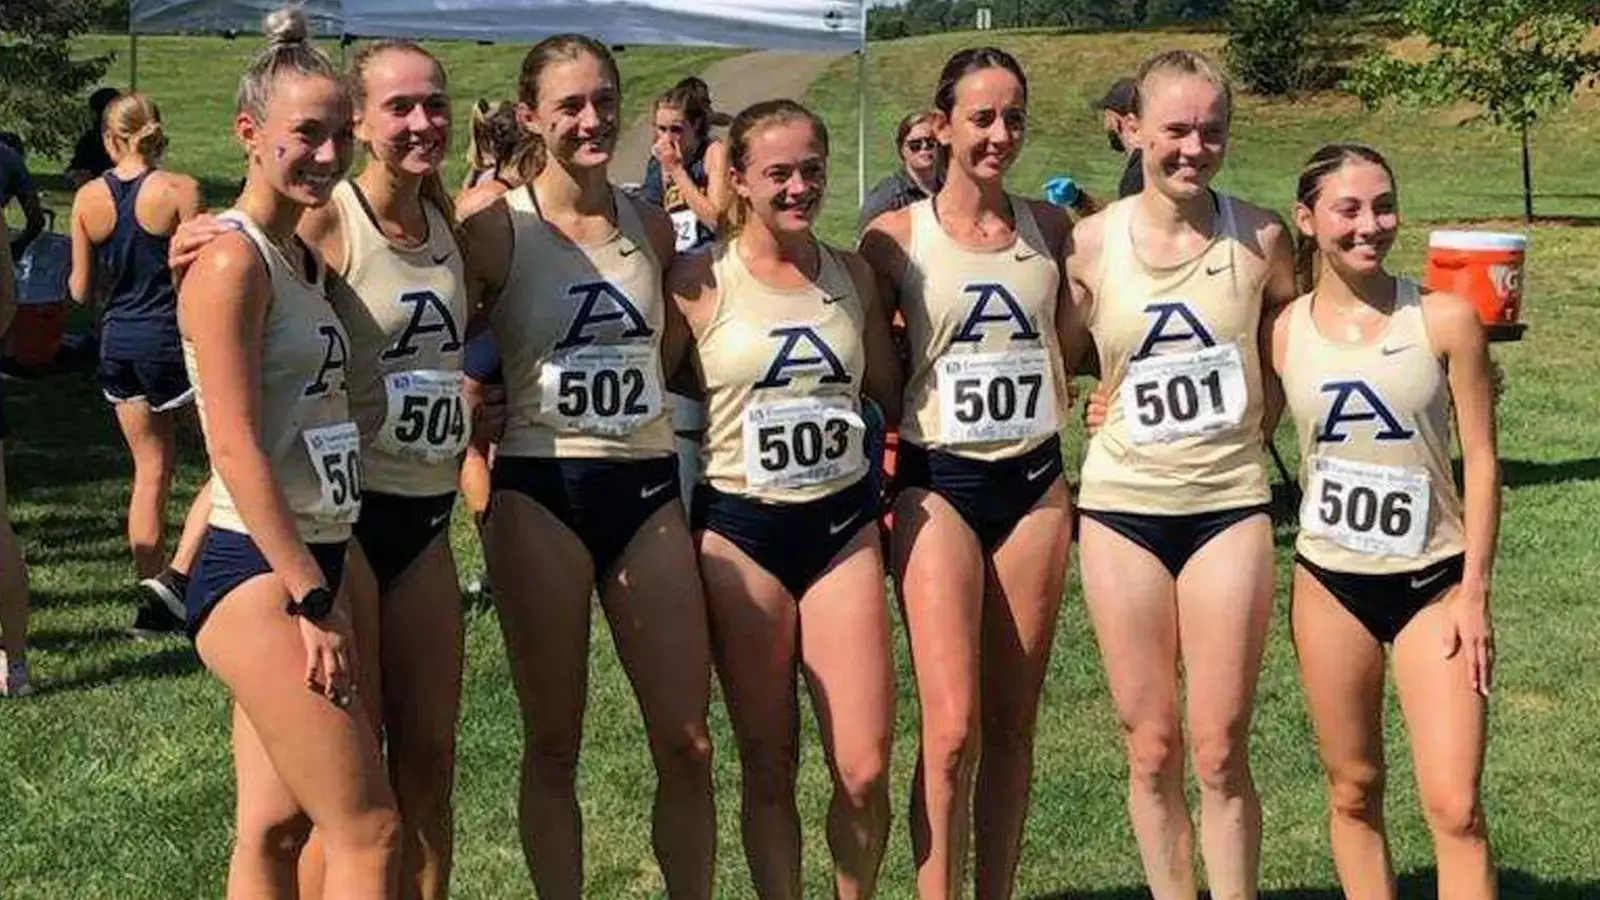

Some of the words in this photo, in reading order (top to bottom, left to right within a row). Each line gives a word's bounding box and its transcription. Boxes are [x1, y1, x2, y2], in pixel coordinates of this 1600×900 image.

[382, 290, 461, 360] A
[554, 281, 654, 351] A
[950, 283, 1041, 342] A
[1129, 302, 1216, 362] A
[305, 326, 347, 395] A
[752, 327, 852, 389] A
[395, 395, 464, 445] 504
[557, 368, 648, 417] 502
[954, 373, 1042, 423] 507
[1134, 370, 1225, 426] 501
[1316, 380, 1415, 442] A
[758, 418, 850, 471] 503
[322, 450, 360, 506] 50
[1319, 478, 1413, 537] 506
